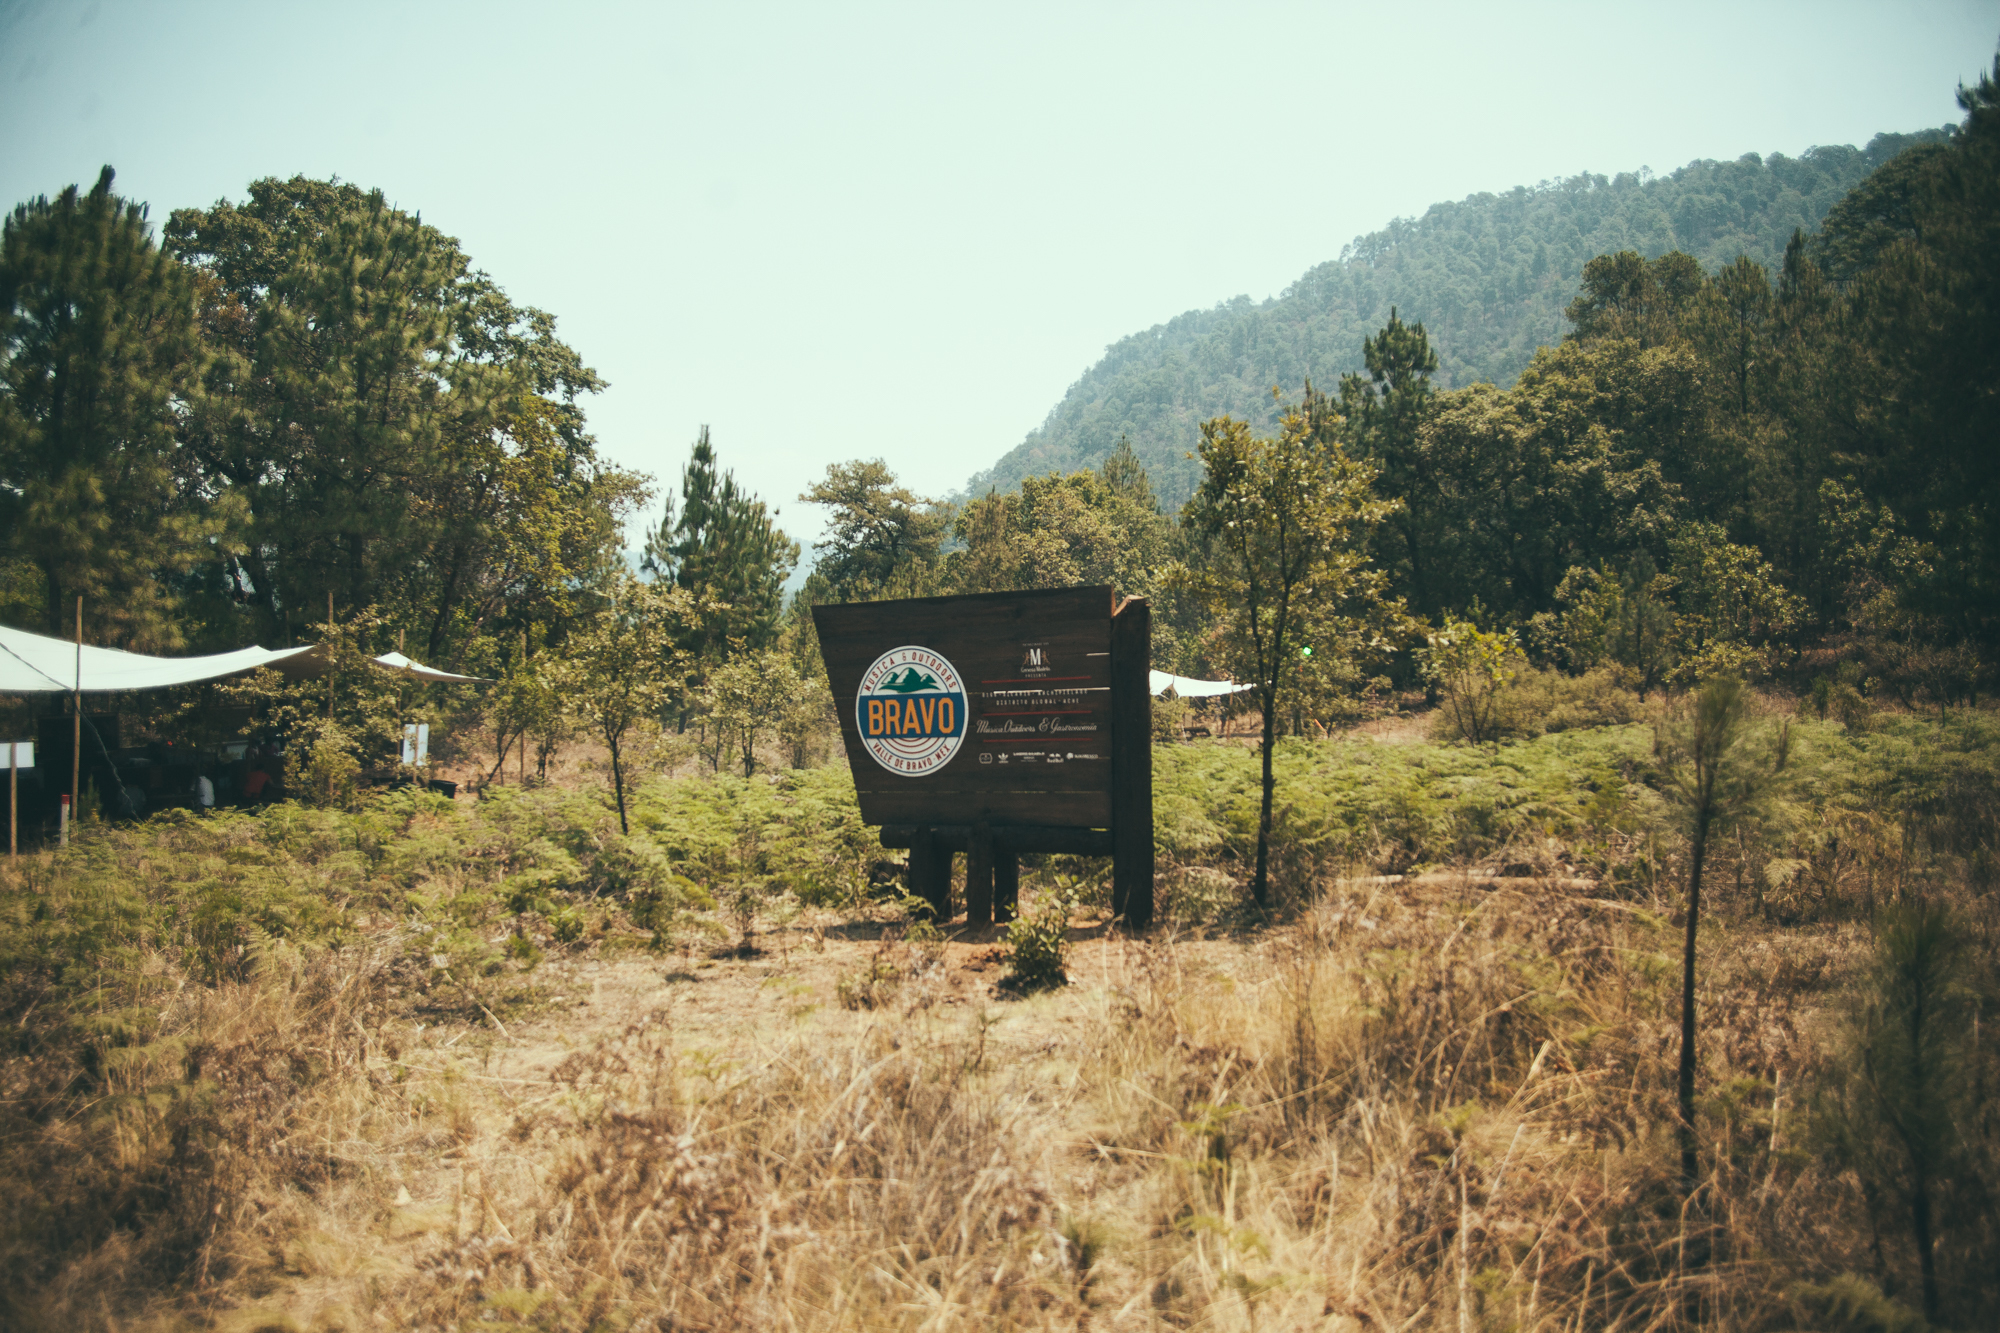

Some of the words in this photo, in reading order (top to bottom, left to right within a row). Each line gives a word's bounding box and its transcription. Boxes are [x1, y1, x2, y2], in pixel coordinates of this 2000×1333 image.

[1030, 648, 1042, 666] M
[863, 657, 895, 692] MUSICA
[912, 652, 957, 689] OUTDOORS
[868, 697, 955, 736] BRAVO
[1038, 717, 1050, 732] &
[872, 743, 892, 763] VALLE
[895, 758, 903, 769] DE
[907, 757, 932, 770] BRAVO
